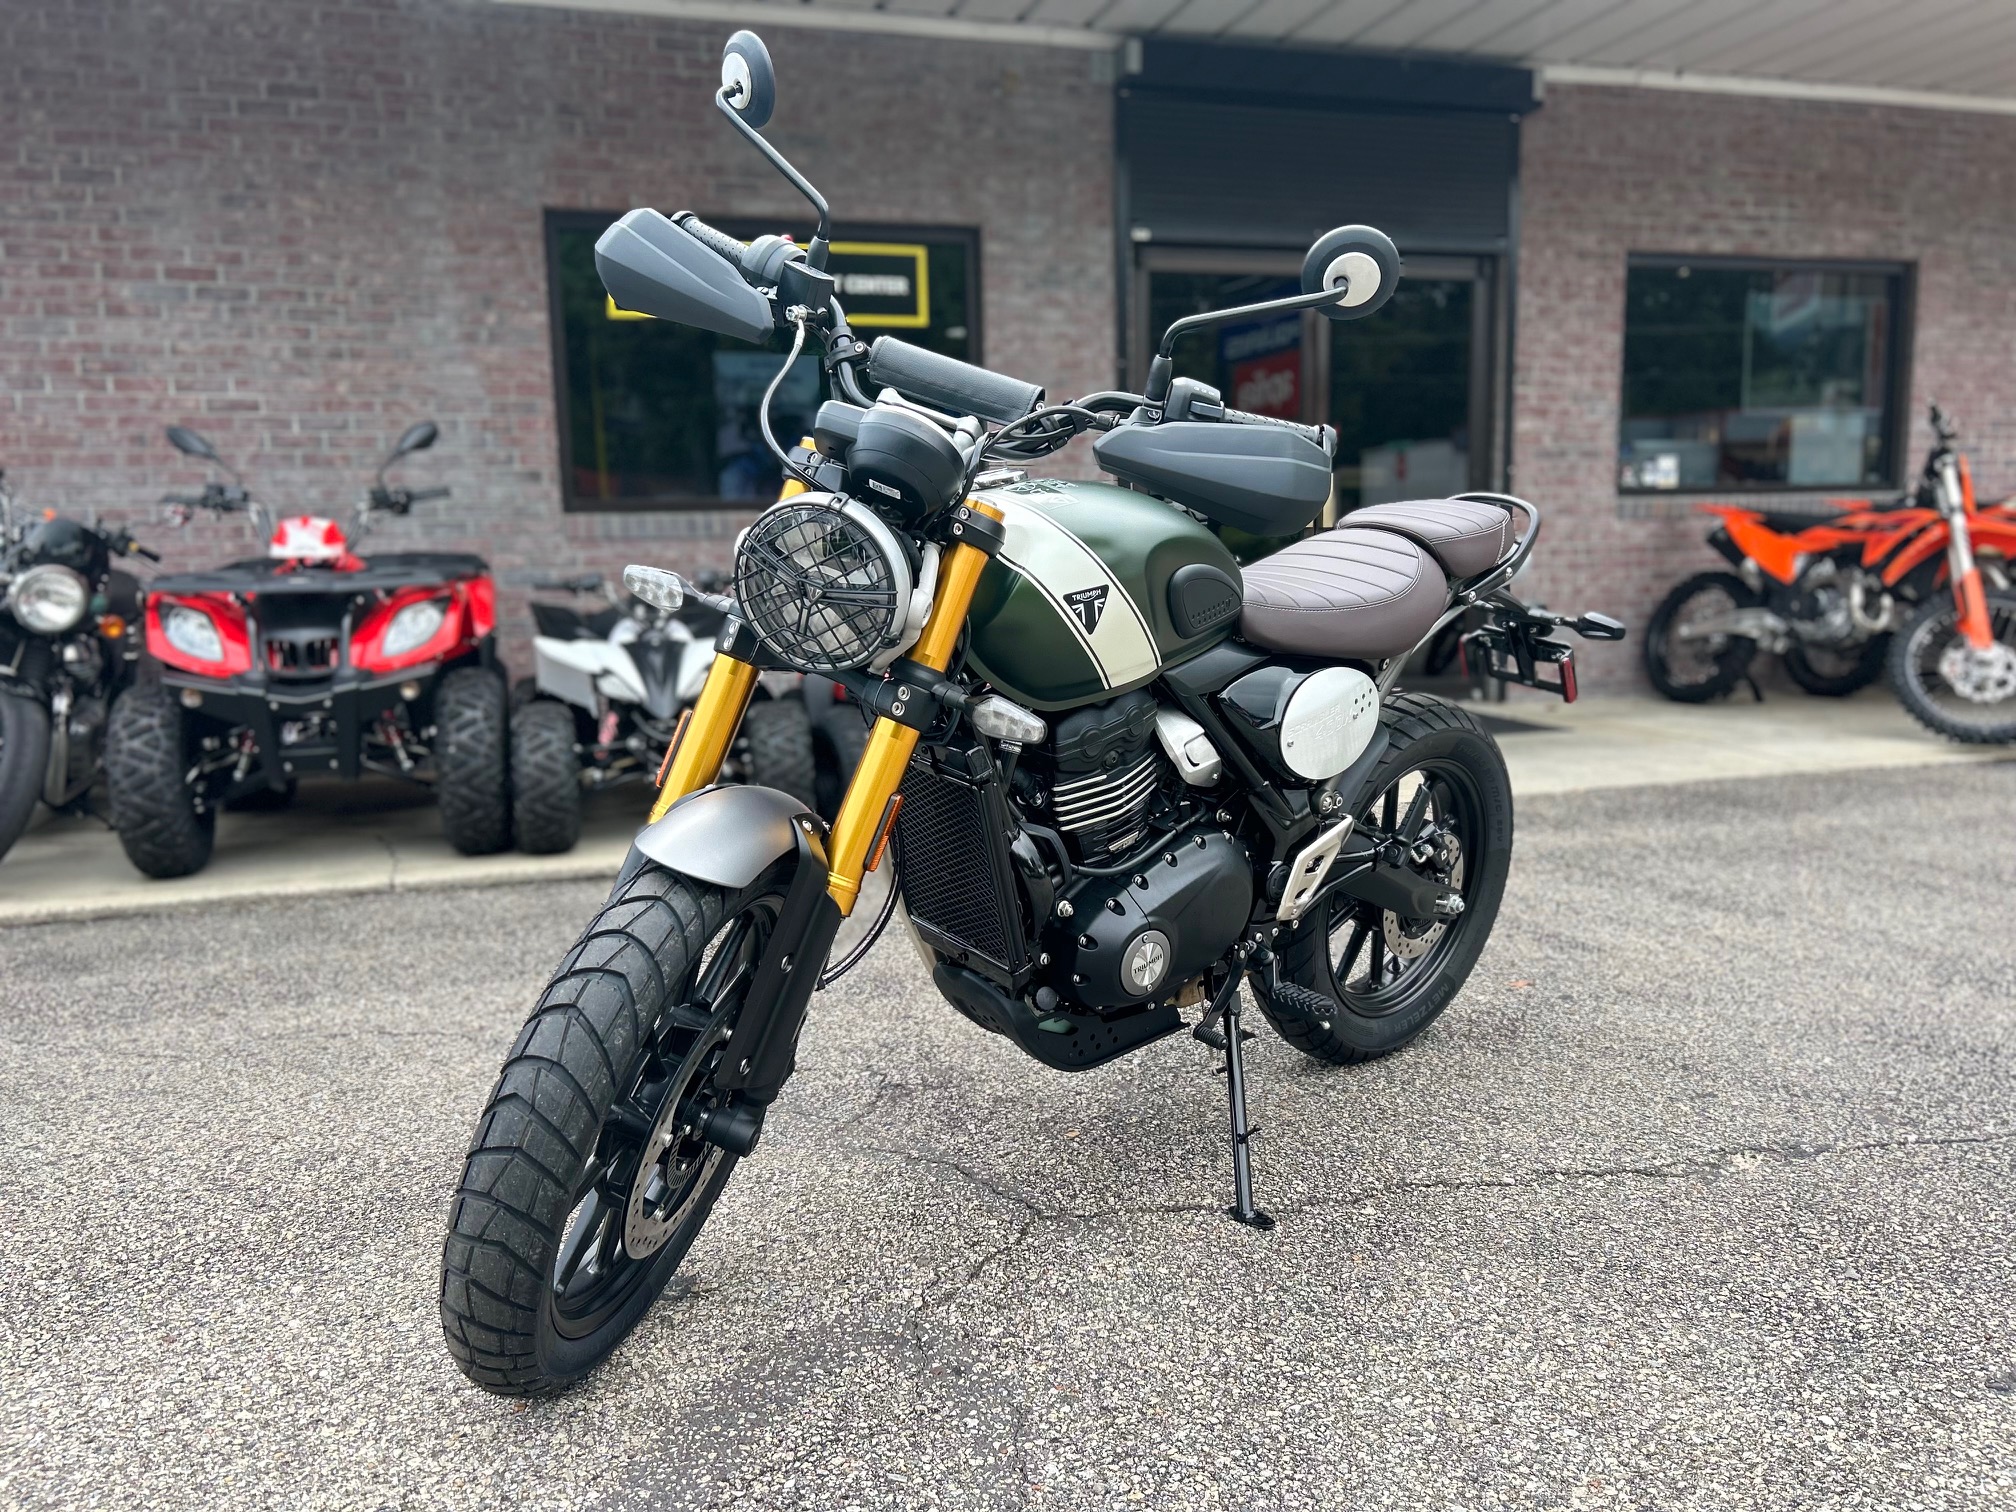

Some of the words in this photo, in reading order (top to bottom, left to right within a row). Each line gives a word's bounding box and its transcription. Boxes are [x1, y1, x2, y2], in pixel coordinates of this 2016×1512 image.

[1071, 588, 1102, 602] TRIUMPH
[1133, 953, 1163, 974] TRIUMPH
[1393, 982, 1451, 1034] METZELER
